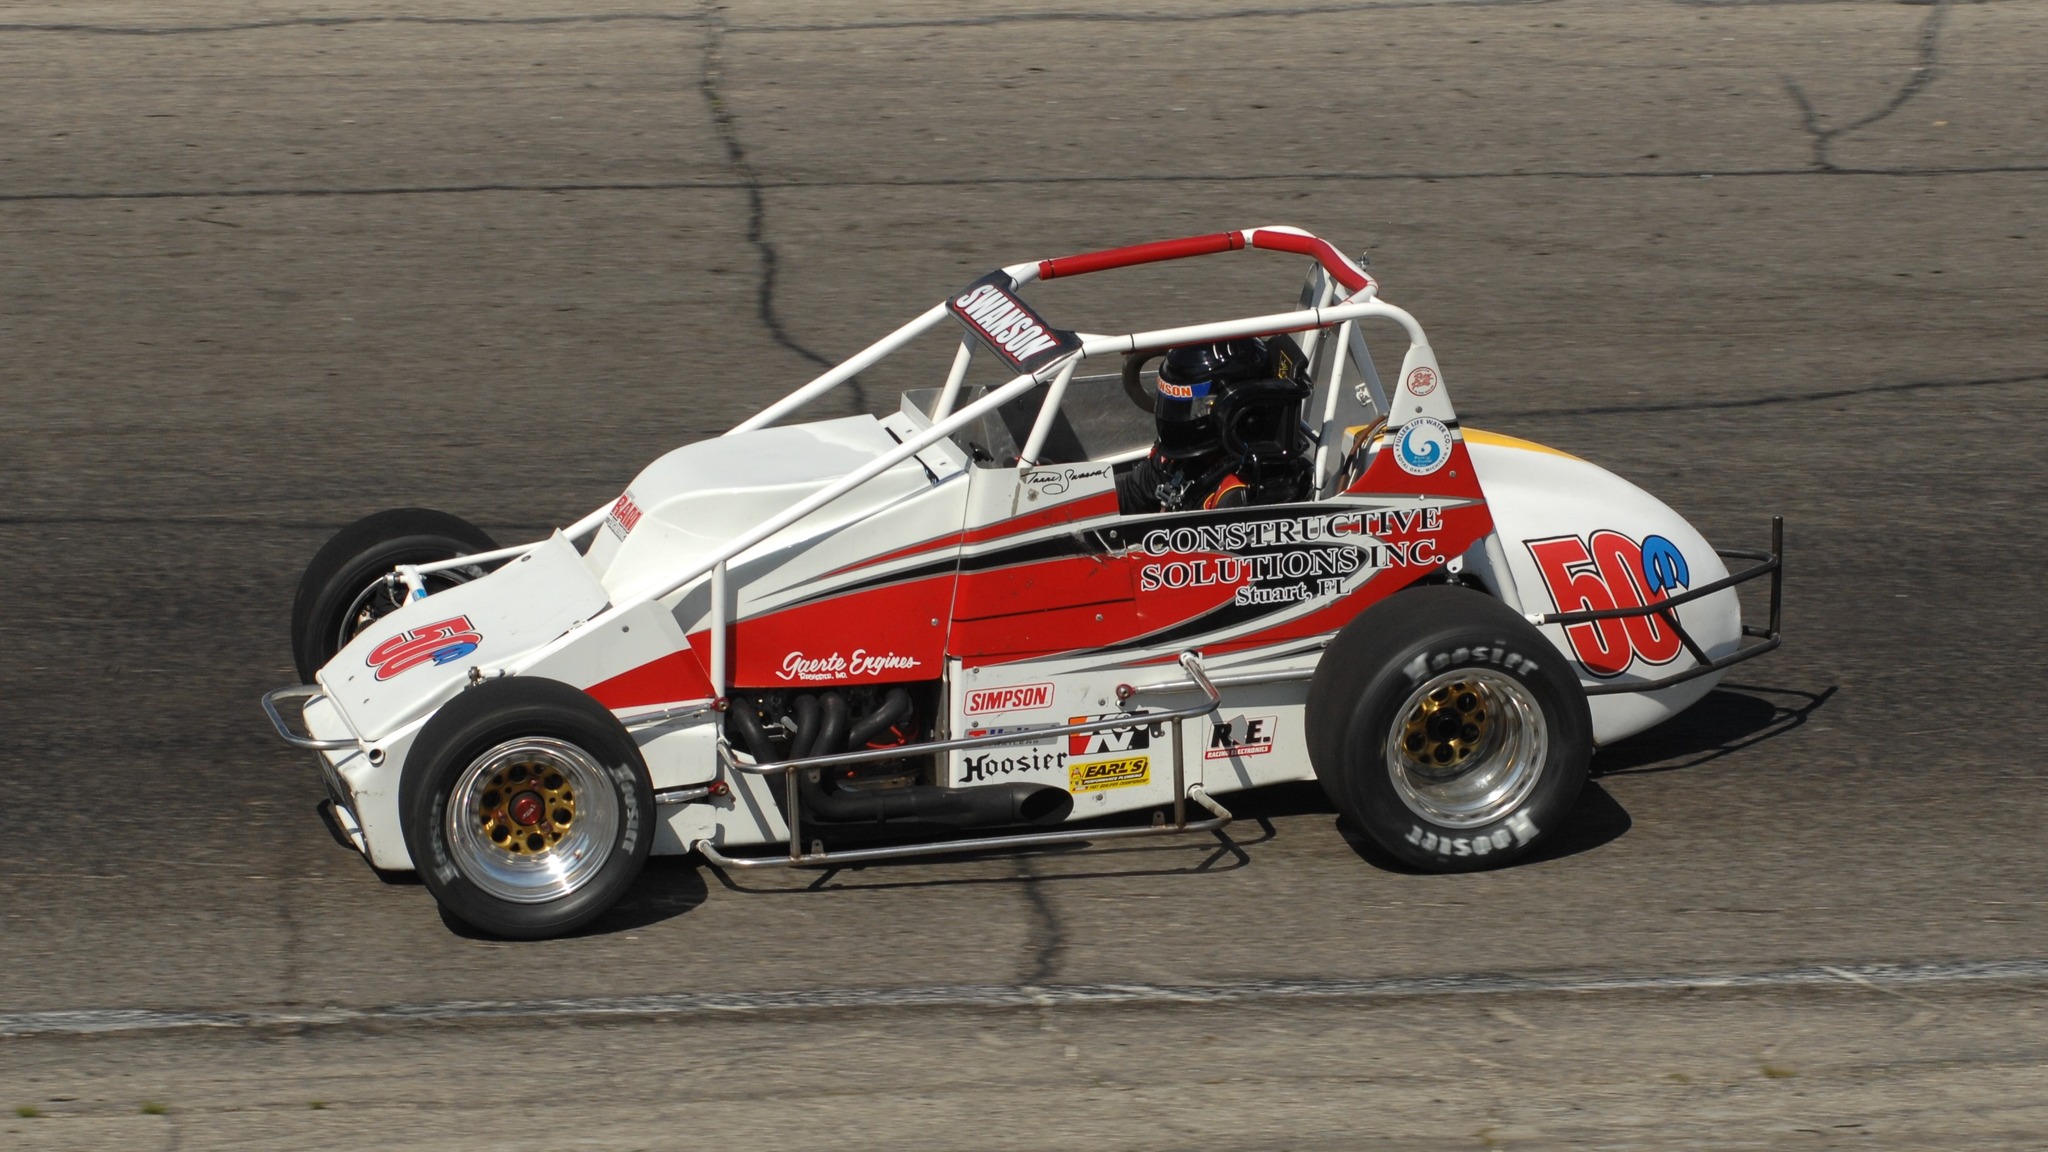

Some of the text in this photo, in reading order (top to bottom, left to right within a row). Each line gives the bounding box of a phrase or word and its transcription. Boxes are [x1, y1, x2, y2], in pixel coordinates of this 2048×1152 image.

[956, 284, 1057, 362] SWANSON
[1395, 425, 1410, 448] FULLER
[1410, 419, 1424, 428] LIFE
[1426, 418, 1447, 434] WATER
[1425, 451, 1449, 472] MICHIGAN
[610, 493, 643, 534] RAM
[1142, 506, 1443, 557] CONSTRUCTIVE
[1140, 538, 1446, 592] SOLUTIONS INC.
[1235, 576, 1352, 607] Stuart, FL
[775, 648, 922, 681] Gaerte Engines
[969, 685, 1049, 712] SIMPSON
[958, 746, 1068, 783] Hoosier
[1084, 759, 1144, 778] EARL'S
[1207, 746, 1269, 759] RACING ELECTRONICS
